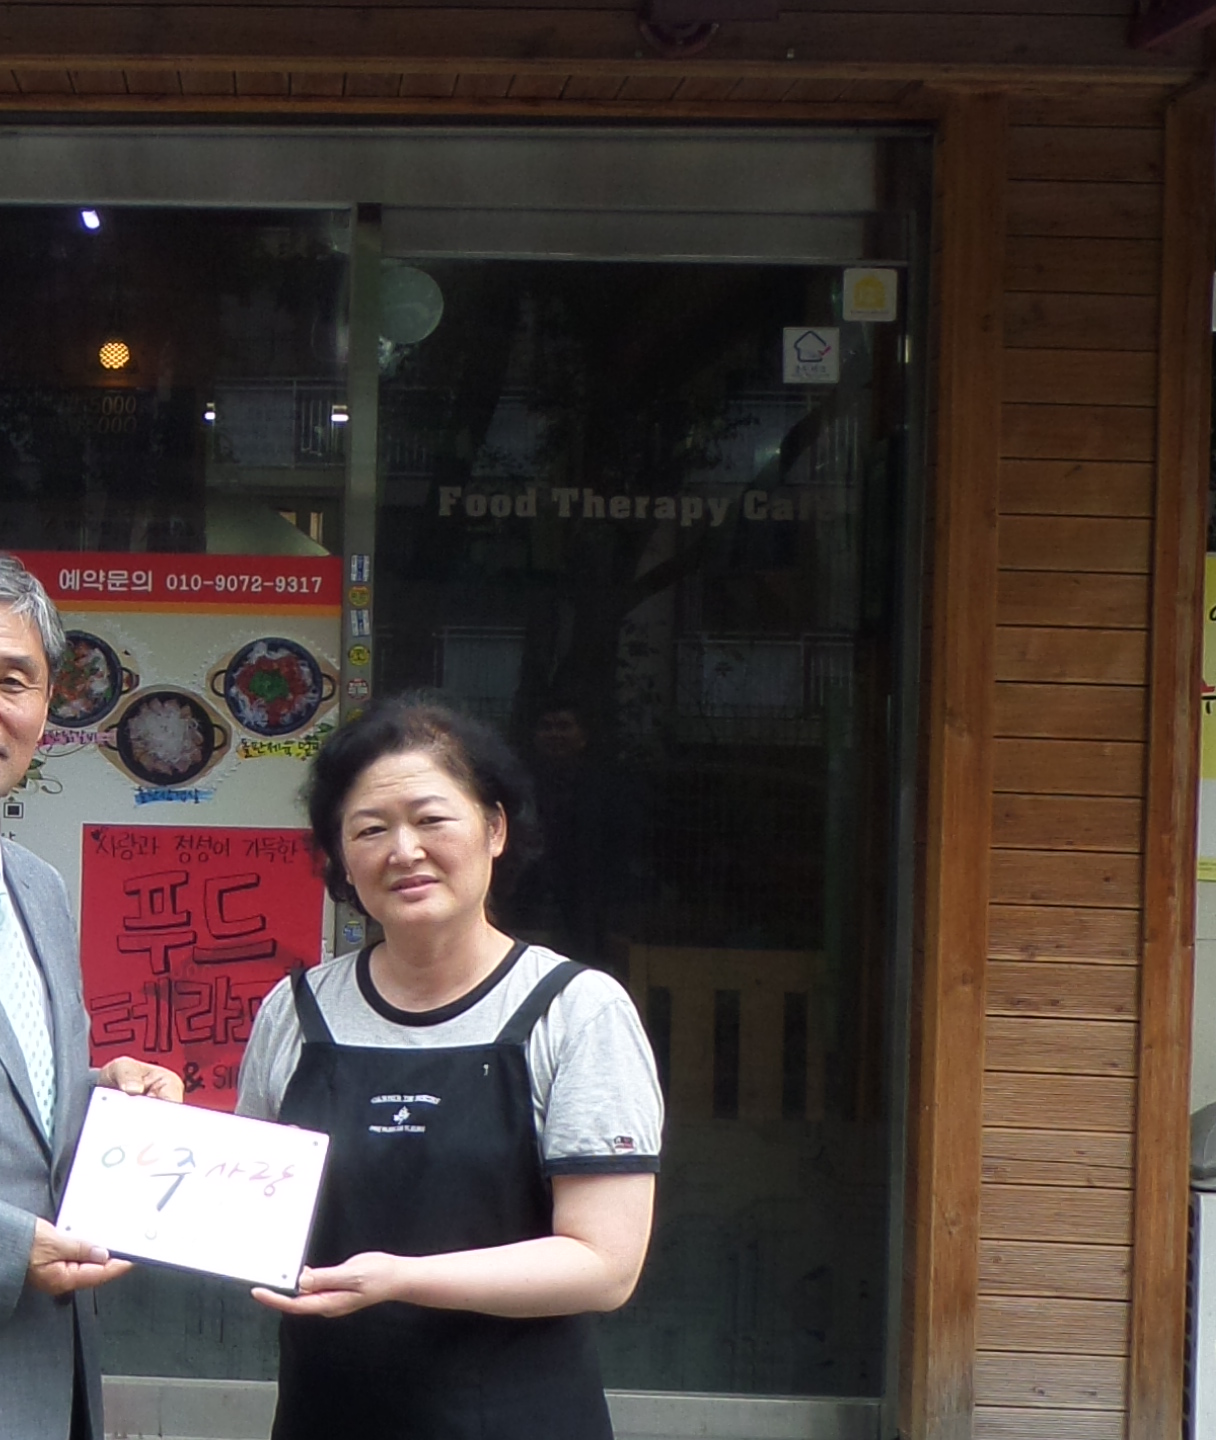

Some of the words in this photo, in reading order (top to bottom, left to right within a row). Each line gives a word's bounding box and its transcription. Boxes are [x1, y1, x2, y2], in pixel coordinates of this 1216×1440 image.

[439, 486, 537, 518] Food
[551, 487, 732, 527] Therapy
[58, 569, 153, 593] 예약문의
[165, 573, 323, 594] 010-9072-9317
[95, 832, 161, 861] 사랑과
[175, 834, 231, 864] 정성이
[116, 868, 278, 976] 푸드
[182, 1061, 206, 1093] &
